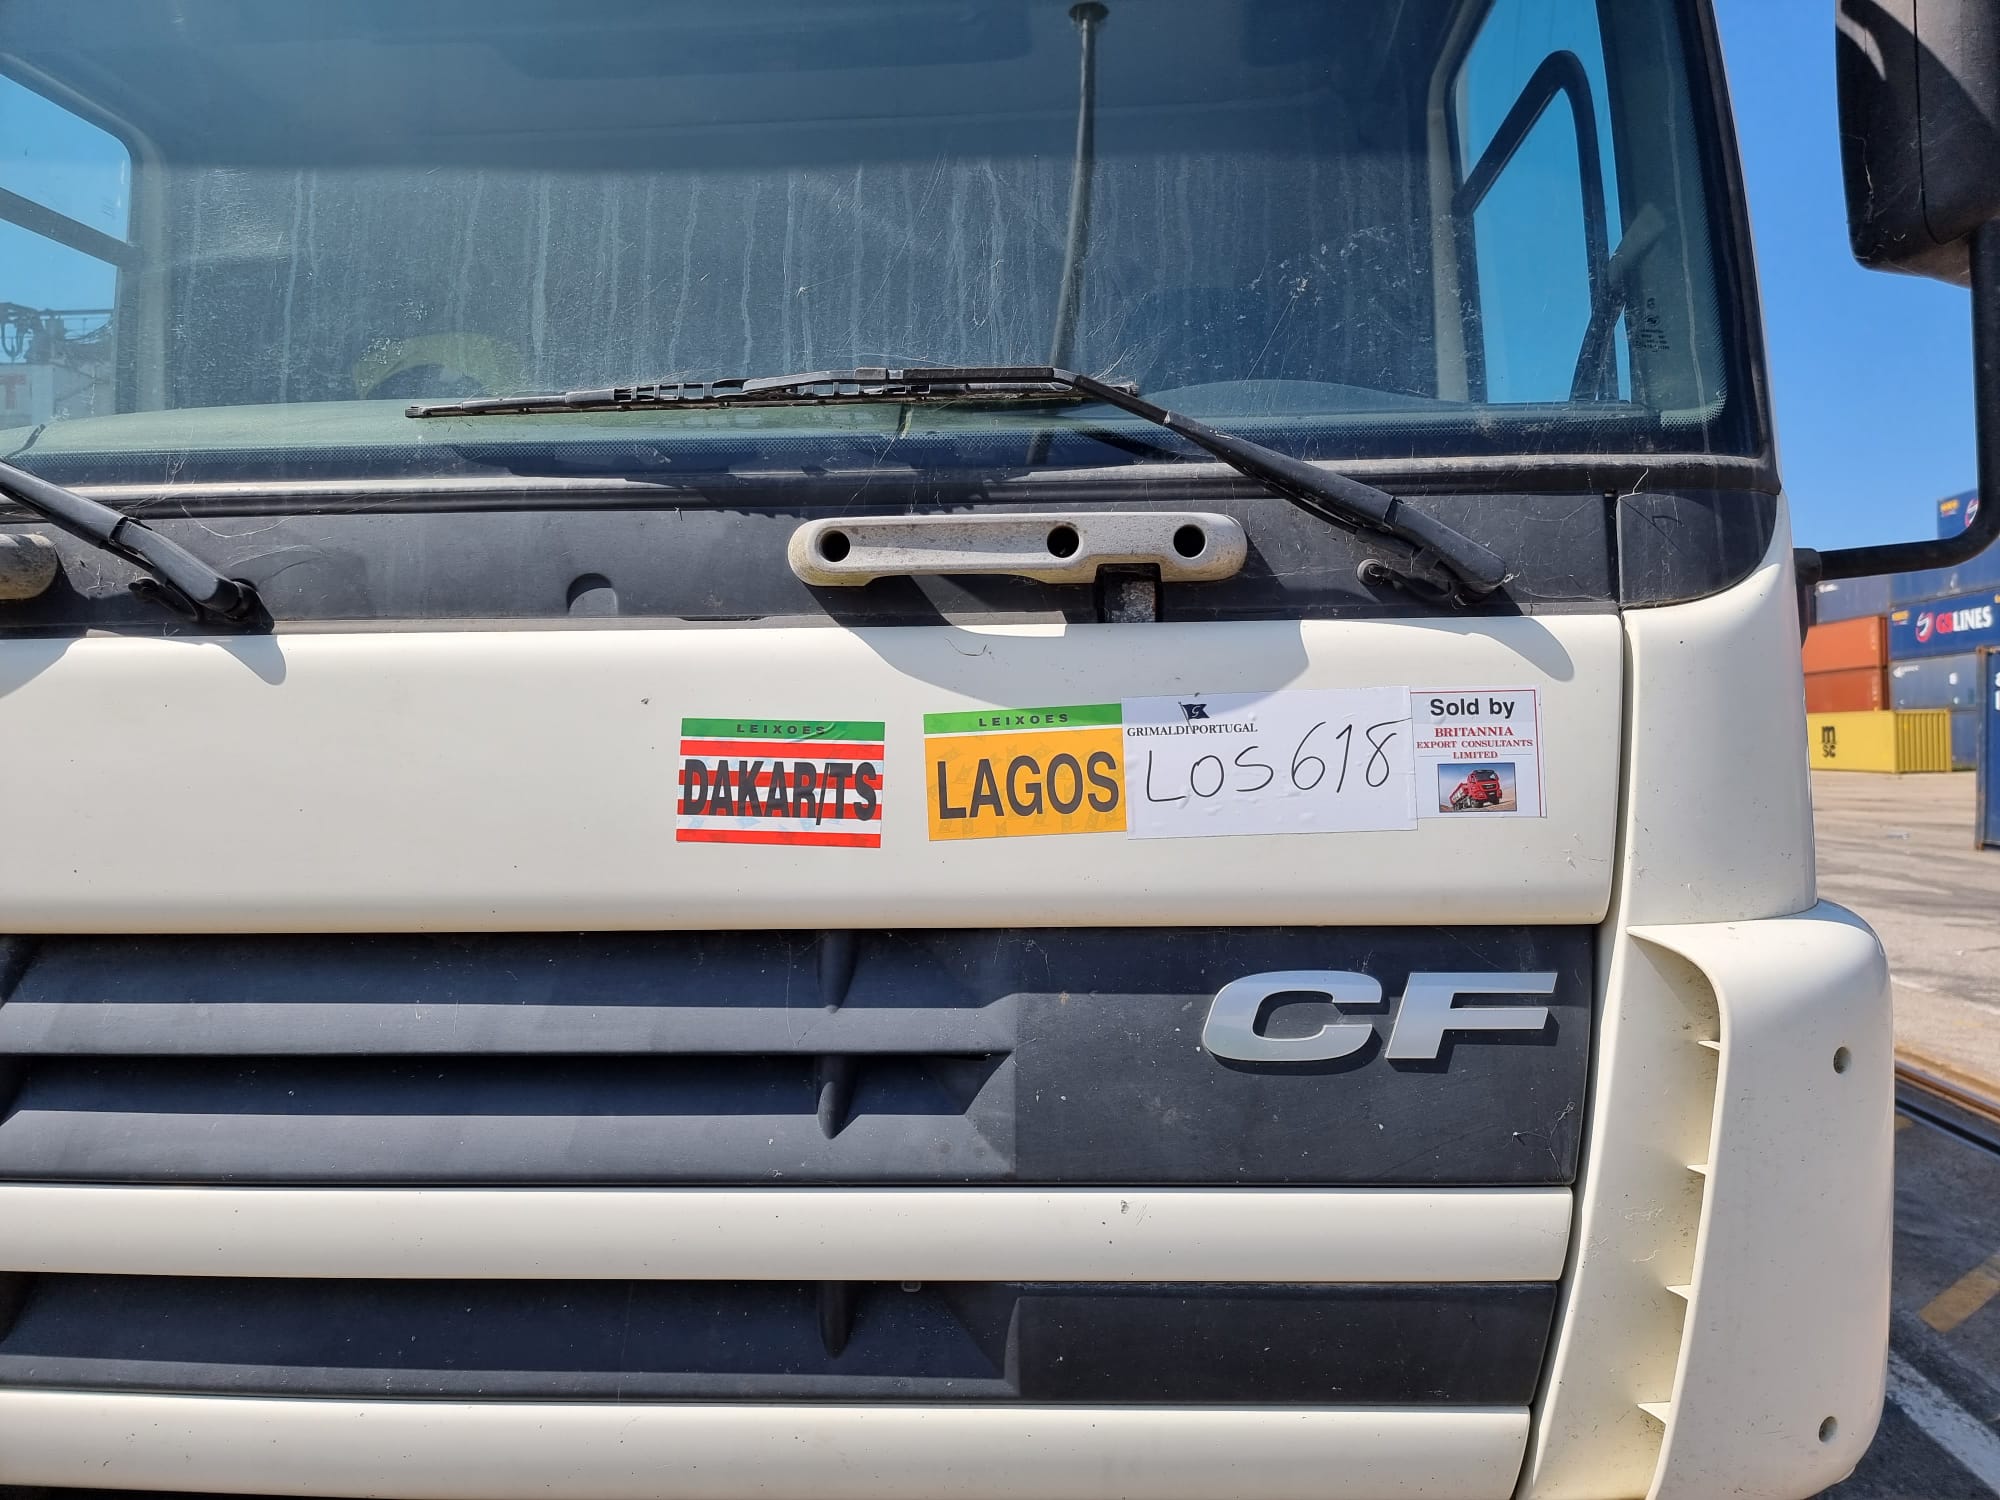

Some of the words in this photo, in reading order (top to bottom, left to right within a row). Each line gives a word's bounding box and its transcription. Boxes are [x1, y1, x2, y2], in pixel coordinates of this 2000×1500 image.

[1430, 698, 1480, 716] Sold
[1489, 697, 1515, 719] by
[978, 713, 1069, 727] LEIXOES
[736, 724, 826, 736] LEIXOES
[1126, 725, 1190, 737] GRIMALDI
[1192, 722, 1259, 735] PORTUGAL
[1434, 726, 1514, 738] BRITANNIA
[1416, 740, 1457, 749] EXPORT
[1461, 739, 1533, 748] CONSULTANTS
[1453, 751, 1498, 759] LIMITED
[683, 758, 878, 826] DAKAR/TS
[937, 751, 1120, 820] LAGOS
[1202, 969, 1559, 1062] CF
